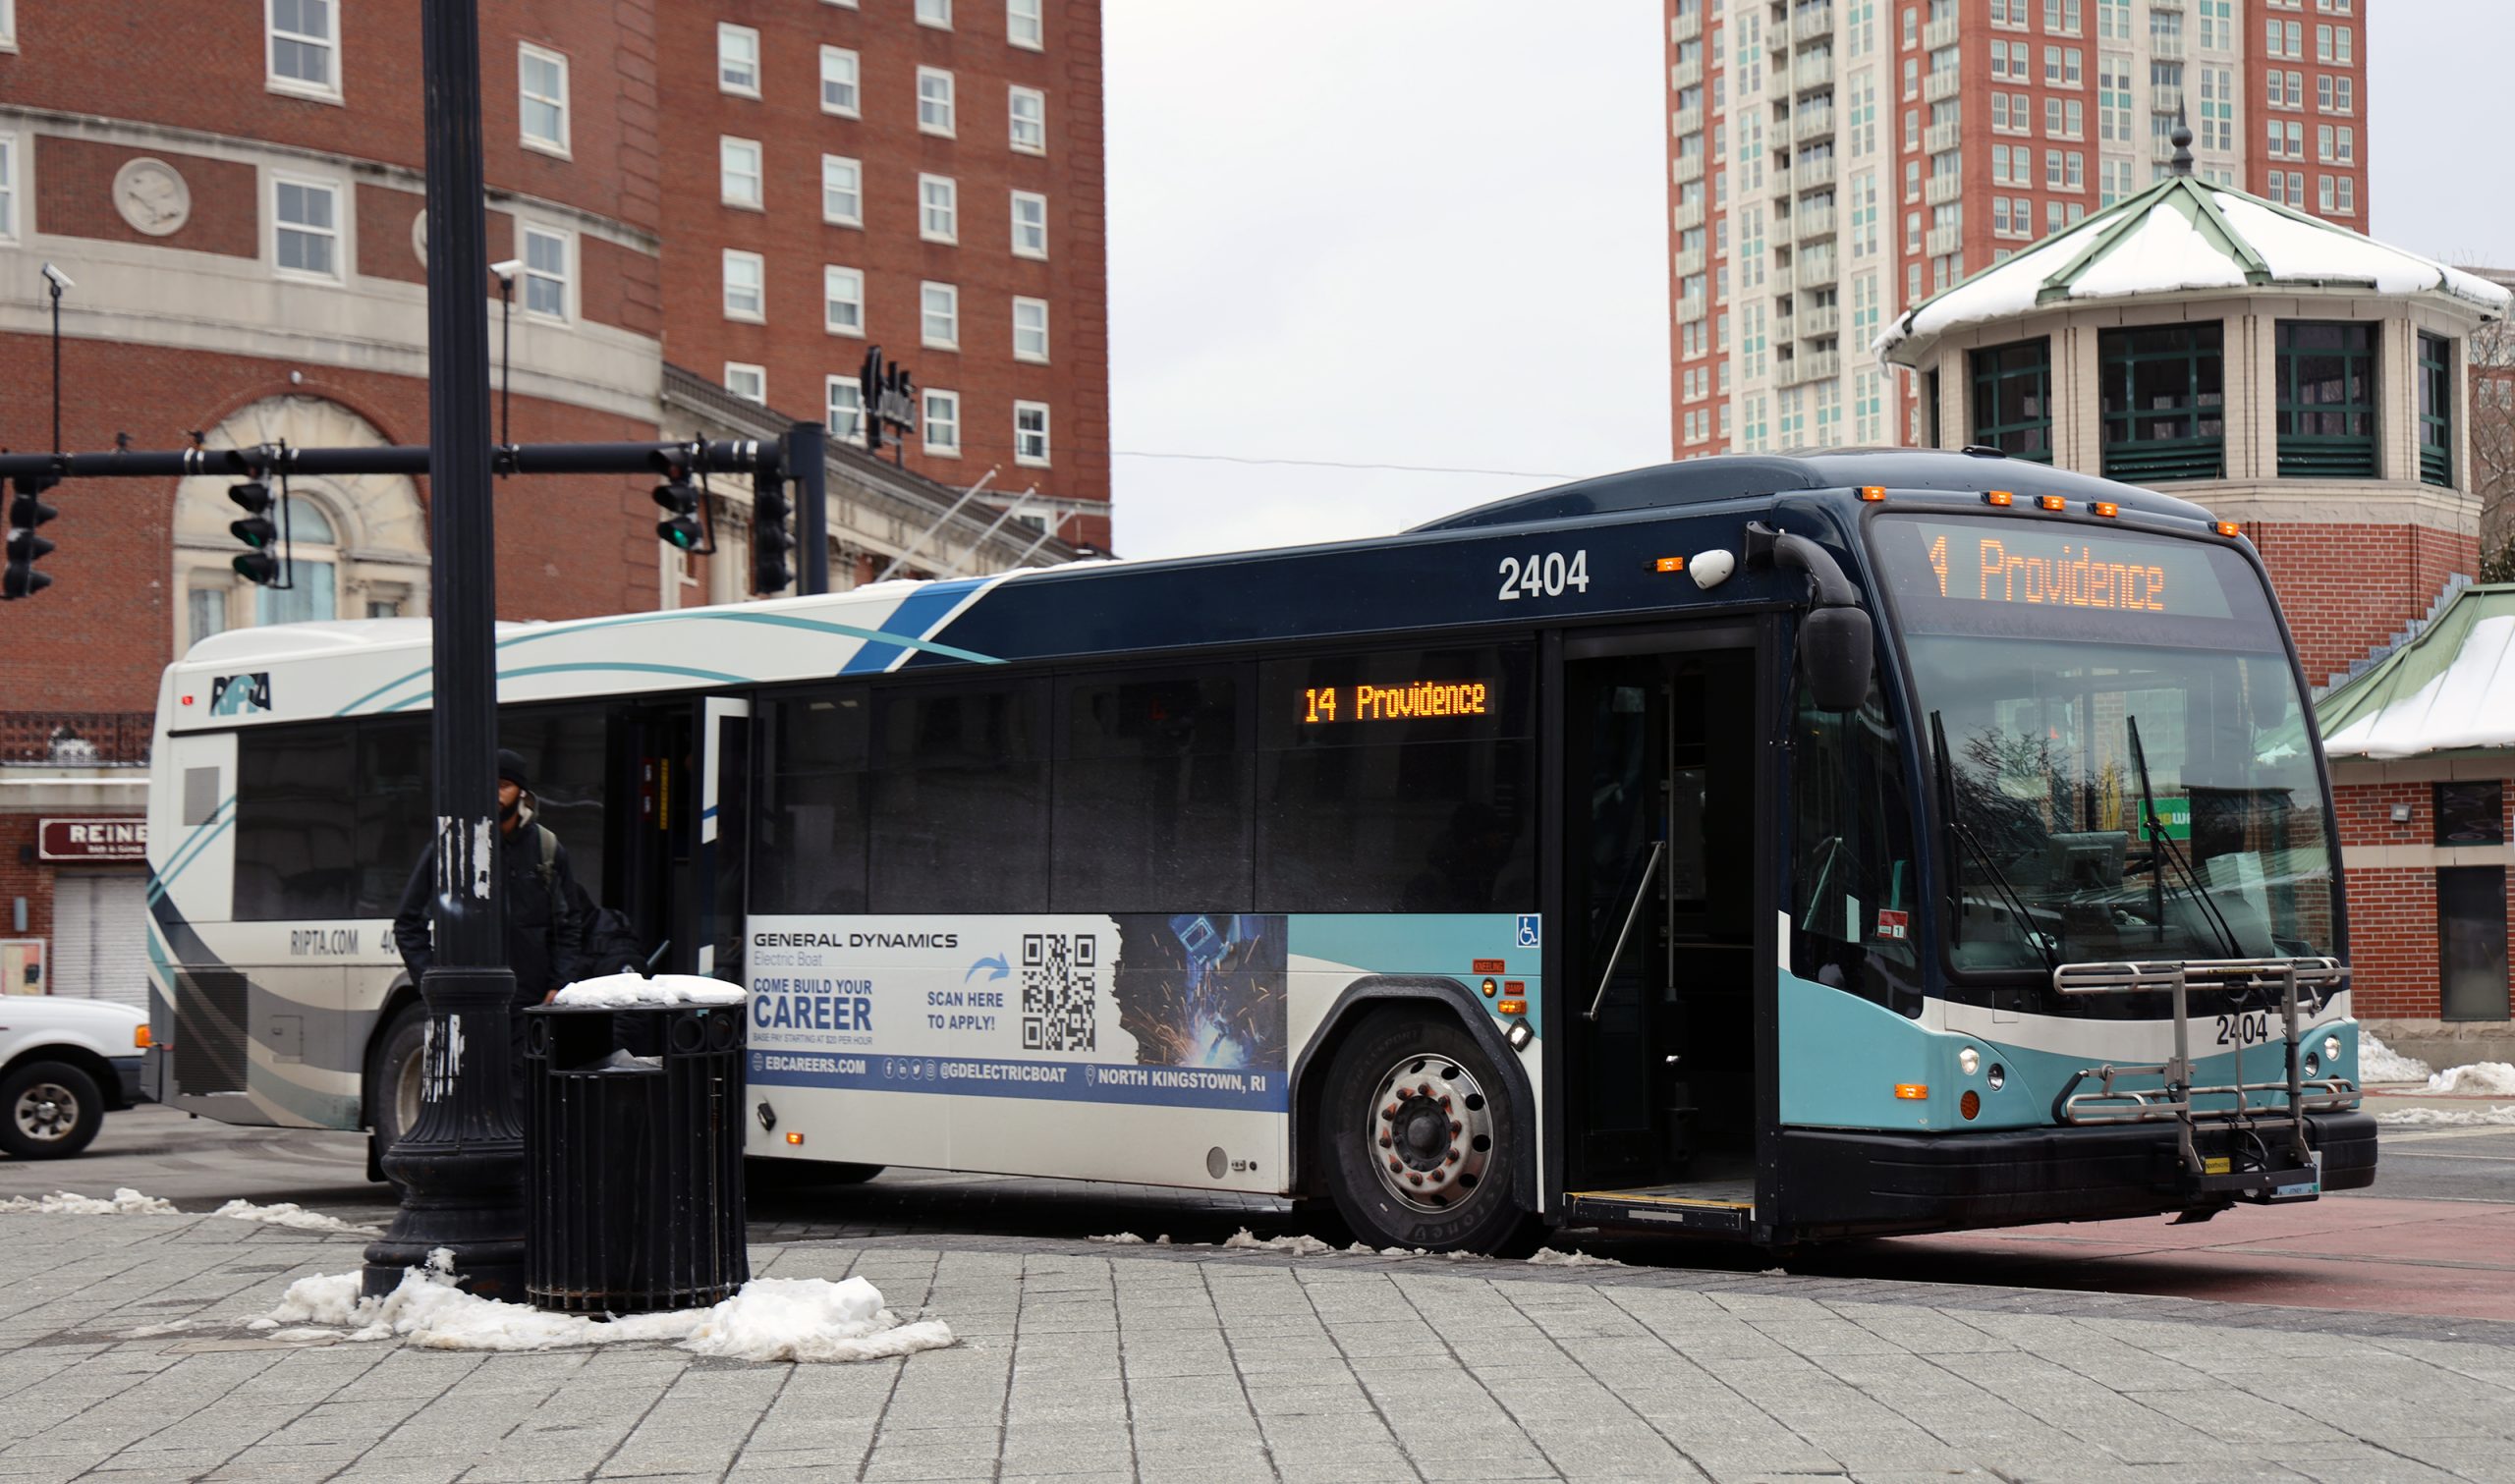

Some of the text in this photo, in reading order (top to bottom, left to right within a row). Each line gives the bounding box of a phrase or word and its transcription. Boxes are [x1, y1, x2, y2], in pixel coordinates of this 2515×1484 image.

[1498, 549, 1590, 601] 2404
[1980, 538, 2164, 611] Providence
[1305, 682, 1485, 722] 14 Providence
[291, 930, 359, 956] RIPTA.COM
[754, 933, 959, 948] GENERAL DYNAMICS
[754, 951, 823, 966] Electric Boat
[754, 977, 873, 995] COME BUILD YOUR
[927, 991, 1003, 1008] SCAN HERE
[754, 994, 873, 1031] CAREER
[927, 1015, 995, 1030] TO APPLY!
[754, 1032, 770, 1042] BASE
[771, 1033, 782, 1042] PAY
[785, 1033, 815, 1043] STARTING
[838, 1035, 852, 1044] PER
[854, 1036, 873, 1045] HOUR
[2216, 1014, 2268, 1045] 2404
[765, 1056, 866, 1074] EBCAREERS.COM
[940, 1062, 1067, 1082] @GDELECTRICBOAT
[1098, 1069, 1266, 1094] NORTH KINGSTOWN, RI
